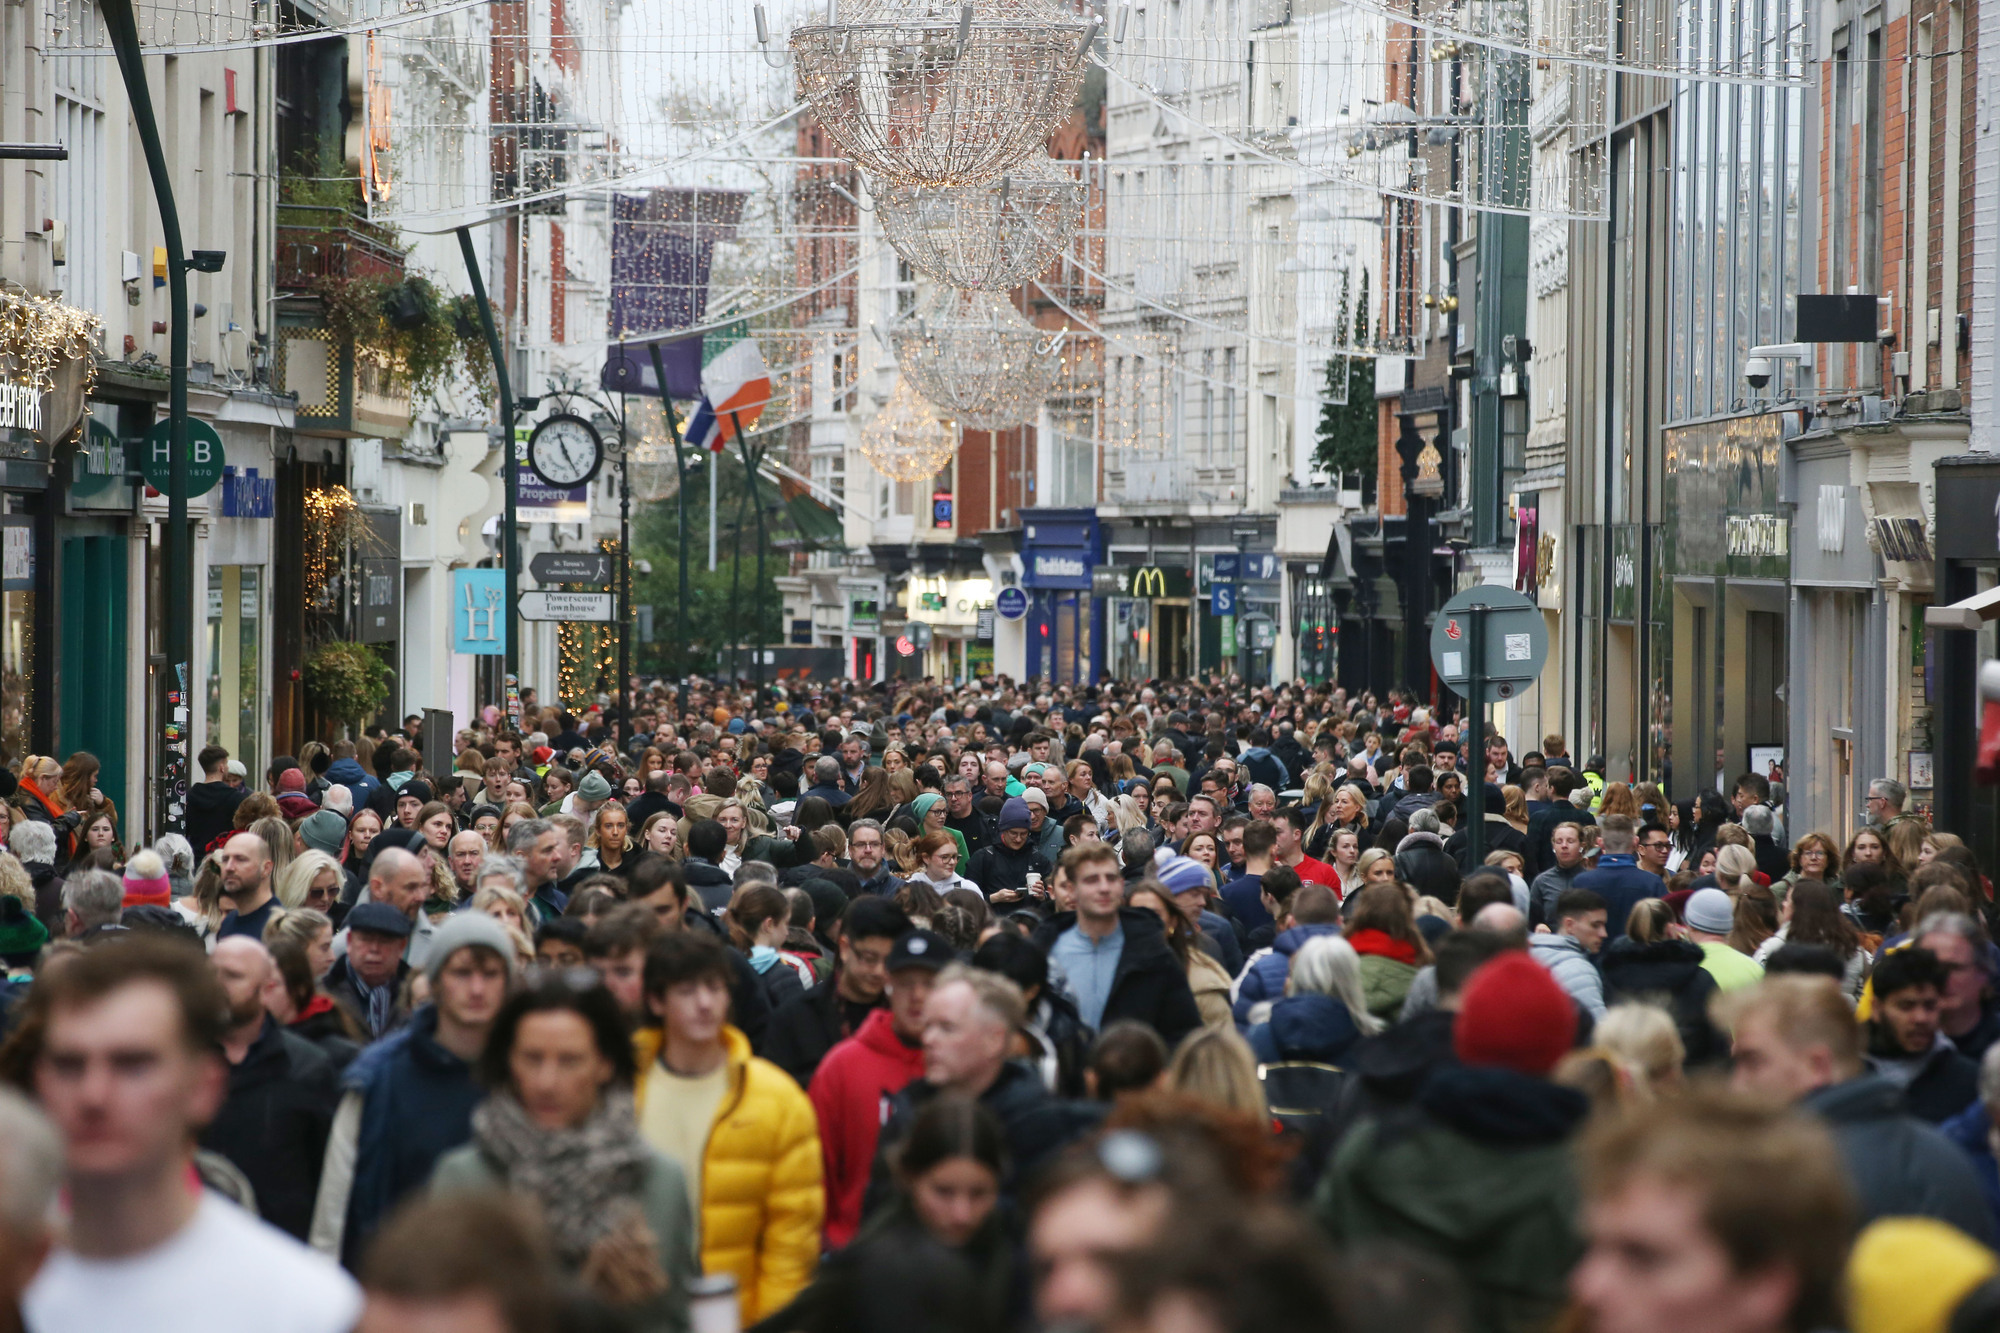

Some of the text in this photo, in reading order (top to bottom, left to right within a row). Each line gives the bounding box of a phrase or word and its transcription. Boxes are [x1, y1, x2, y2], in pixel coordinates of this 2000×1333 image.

[18, 375, 42, 431] mark
[519, 488, 570, 502] Property
[545, 593, 603, 602] Powerscourt
[1218, 589, 1231, 610] S
[545, 603, 596, 612] Townhouse
